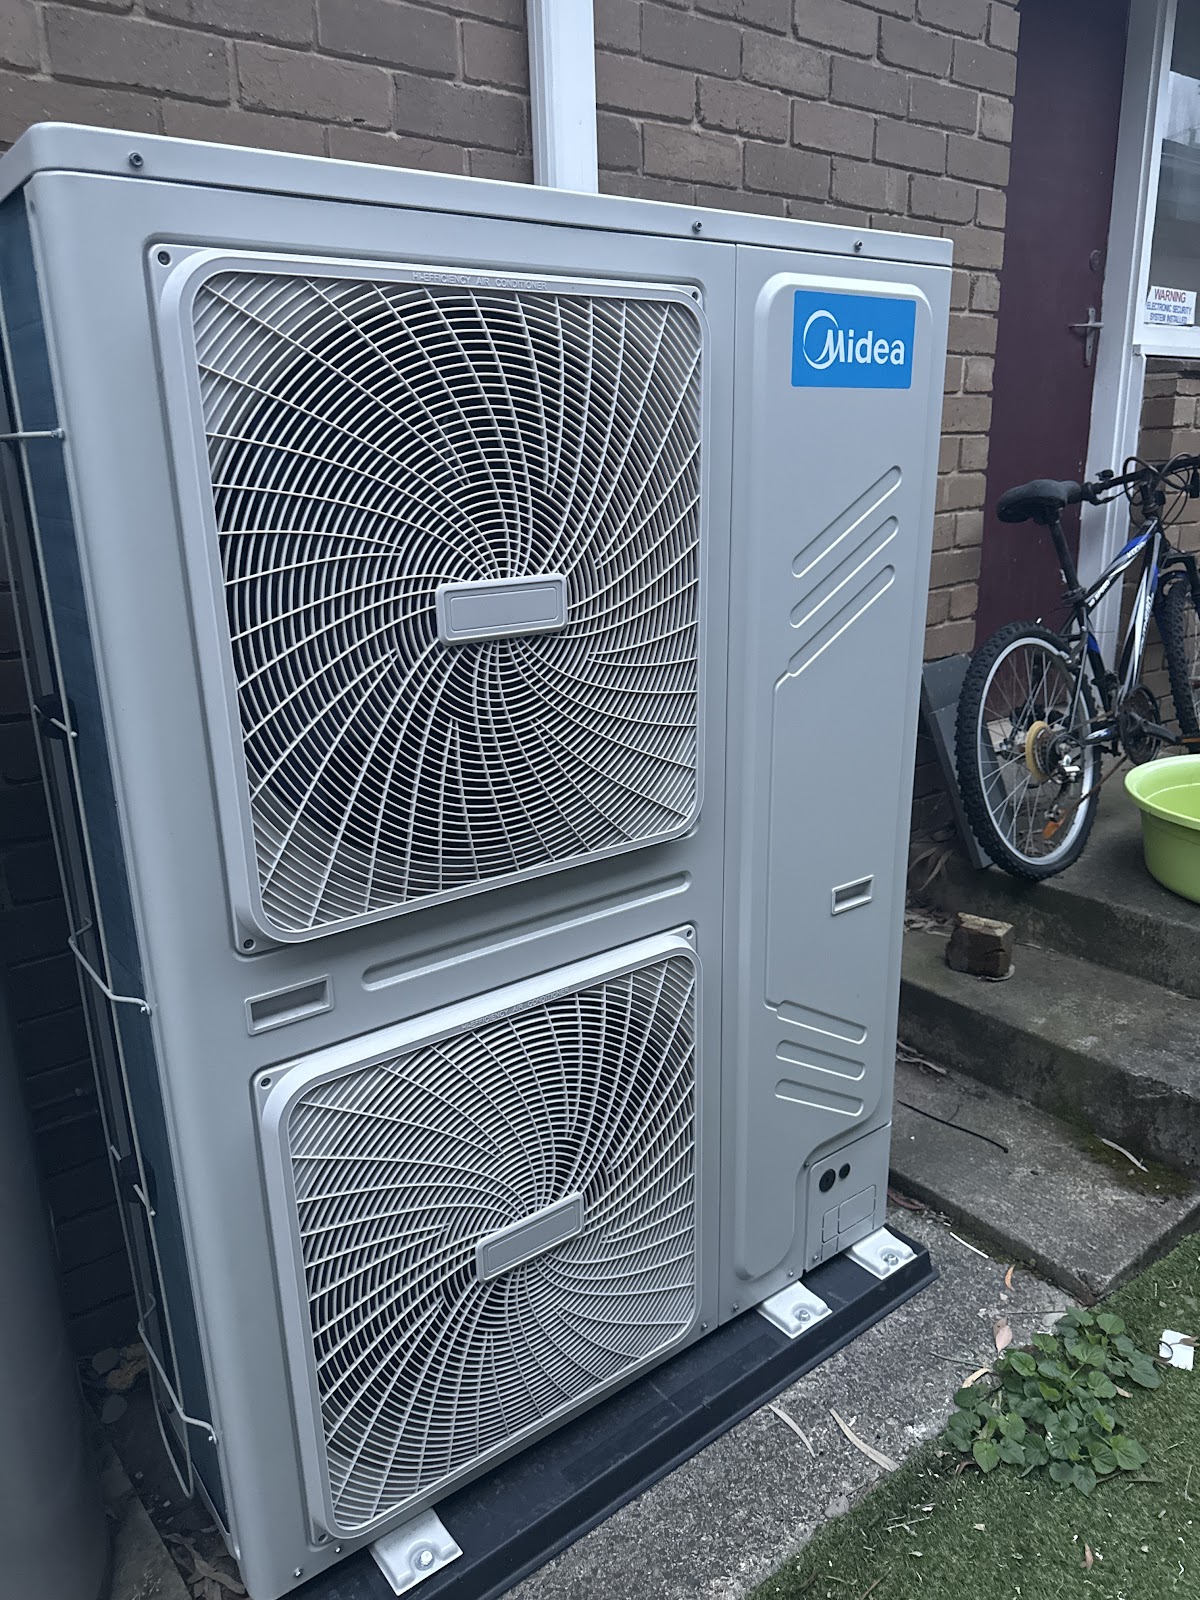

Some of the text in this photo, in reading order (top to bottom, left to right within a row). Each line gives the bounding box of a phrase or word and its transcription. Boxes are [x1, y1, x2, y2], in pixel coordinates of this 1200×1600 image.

[412, 271, 548, 290] HI-EFFICIENCY AIR CONDITIONER
[1154, 288, 1187, 303] WARNING
[1146, 301, 1192, 315] ELECTRONIC SECURITY
[1149, 312, 1188, 325] SYSTEM INSTALLED
[803, 309, 905, 370] Midea
[461, 987, 570, 1030] HI-EFFICIENCY AIR CONDITIONER
